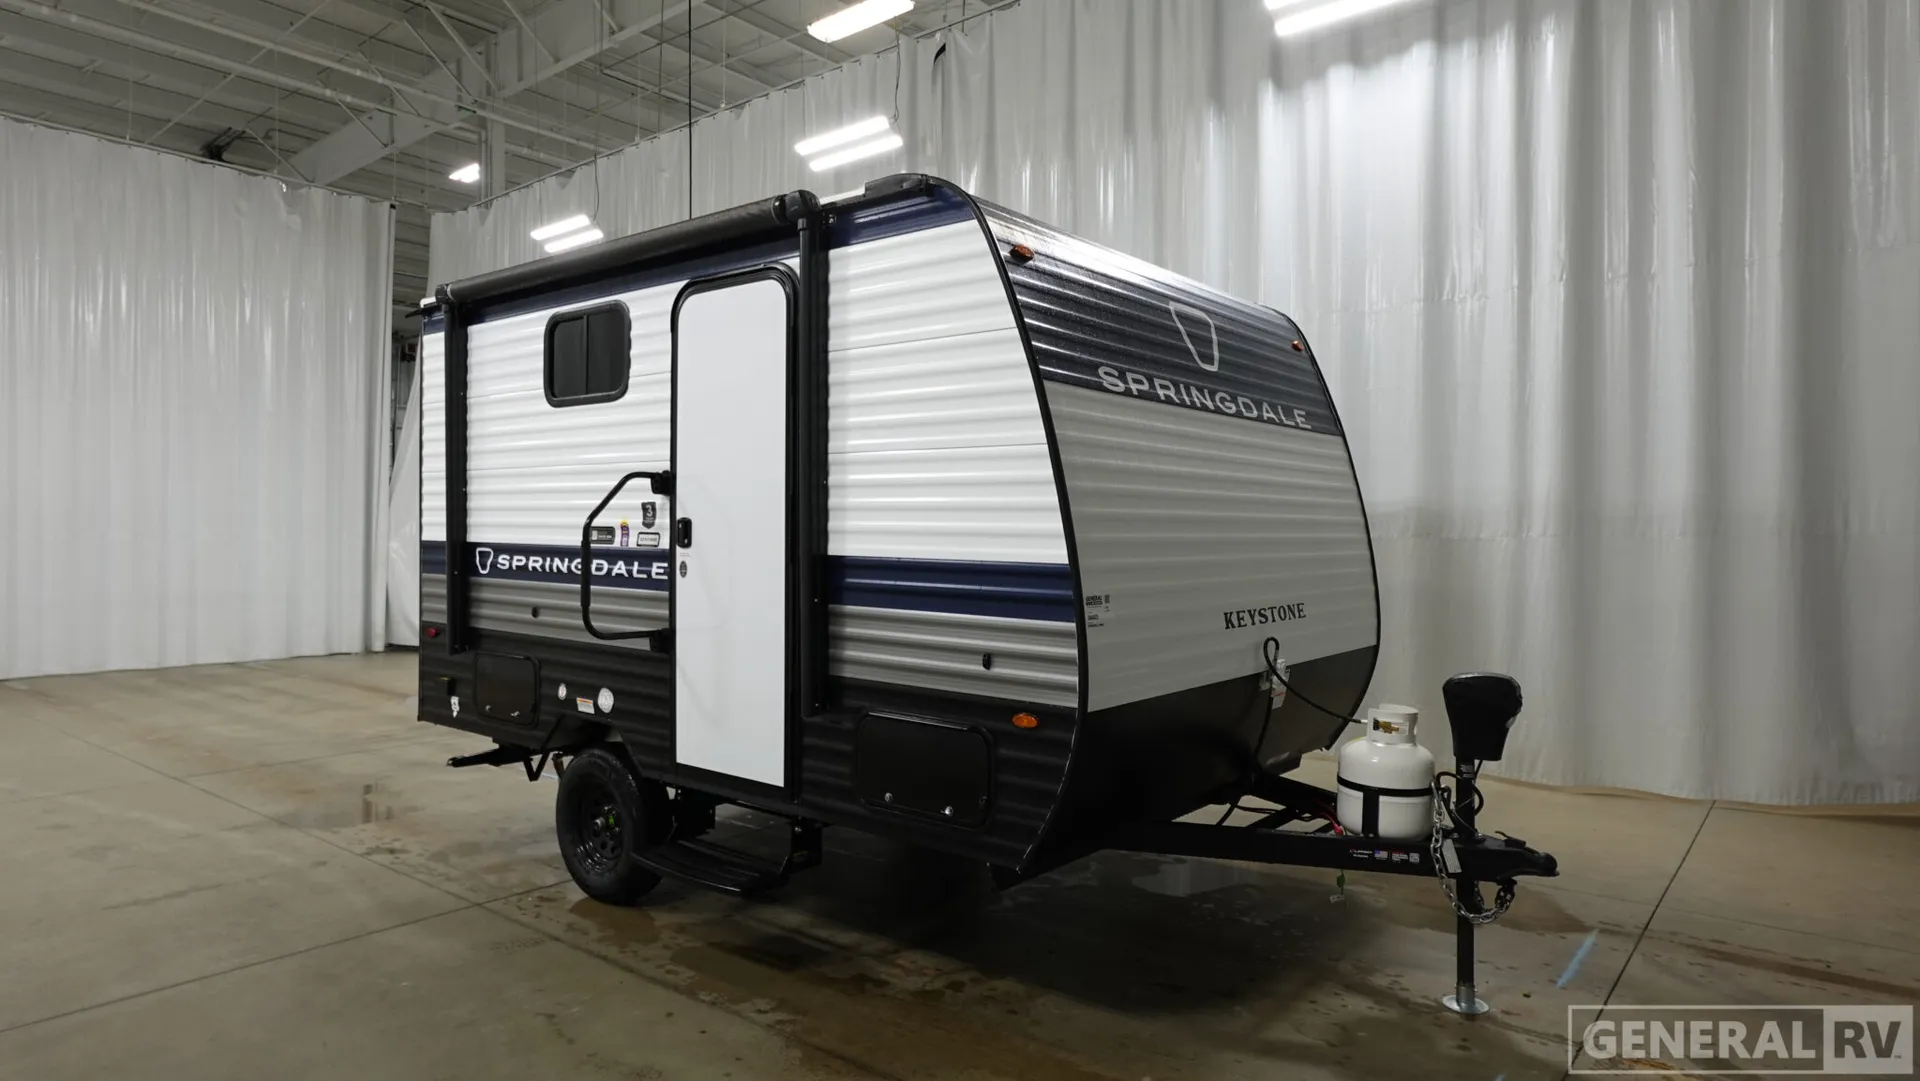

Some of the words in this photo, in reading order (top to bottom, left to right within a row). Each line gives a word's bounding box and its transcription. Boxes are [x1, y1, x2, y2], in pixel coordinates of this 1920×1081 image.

[1098, 366, 1312, 429] SPRINGDALE
[645, 504, 654, 517] 3
[497, 554, 669, 580] SPRINGDALE
[1223, 603, 1307, 630] KEYSTONE
